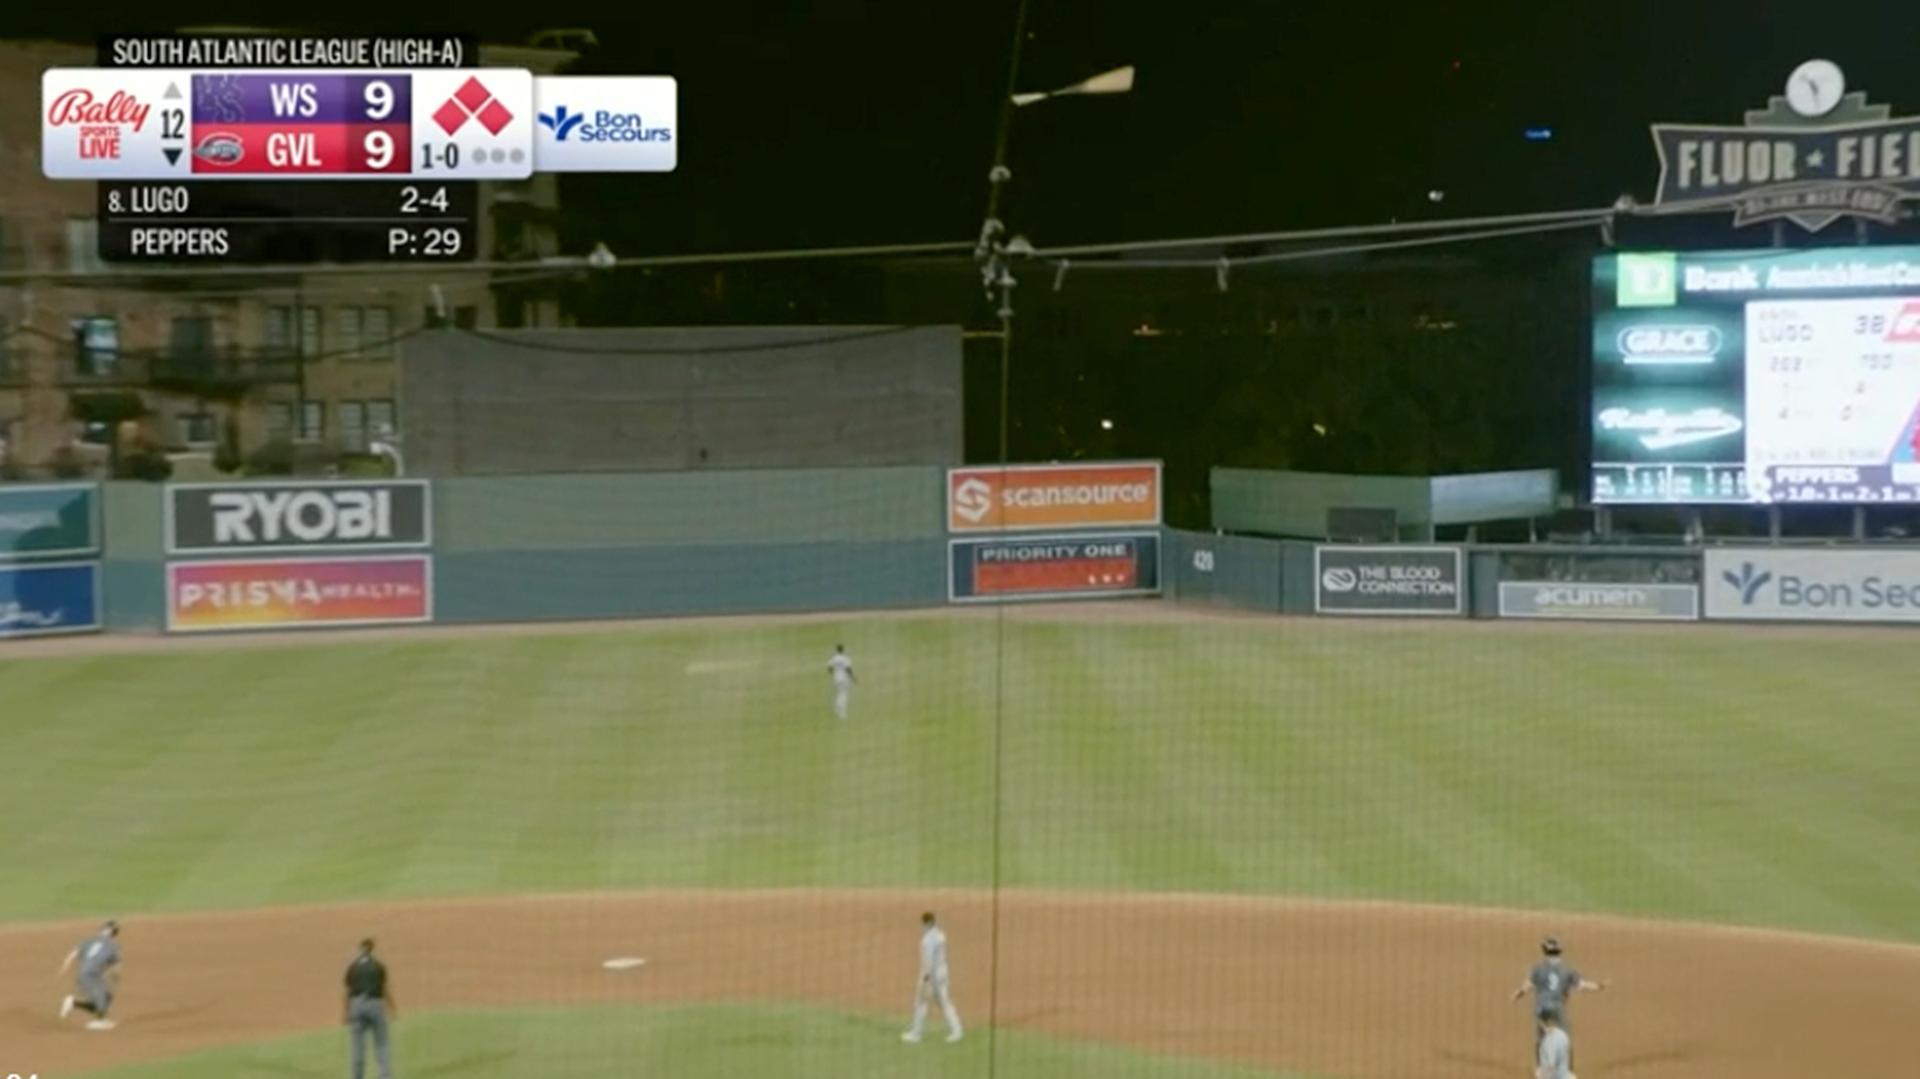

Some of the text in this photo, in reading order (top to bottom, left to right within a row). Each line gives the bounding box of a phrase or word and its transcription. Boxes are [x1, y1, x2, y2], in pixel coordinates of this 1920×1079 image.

[1677, 140, 1798, 189] FLUOR
[1685, 264, 1760, 291] Bank
[1003, 481, 1149, 507] scansource
[208, 488, 393, 543] RYOBI
[982, 543, 1127, 561] PRIORITY ONE
[1358, 566, 1441, 580] THE BLOOD
[178, 578, 322, 609] PRISMA
[1358, 581, 1455, 595] CONNECTION
[1535, 587, 1646, 606] acumen
[1779, 575, 1852, 607] Bon
